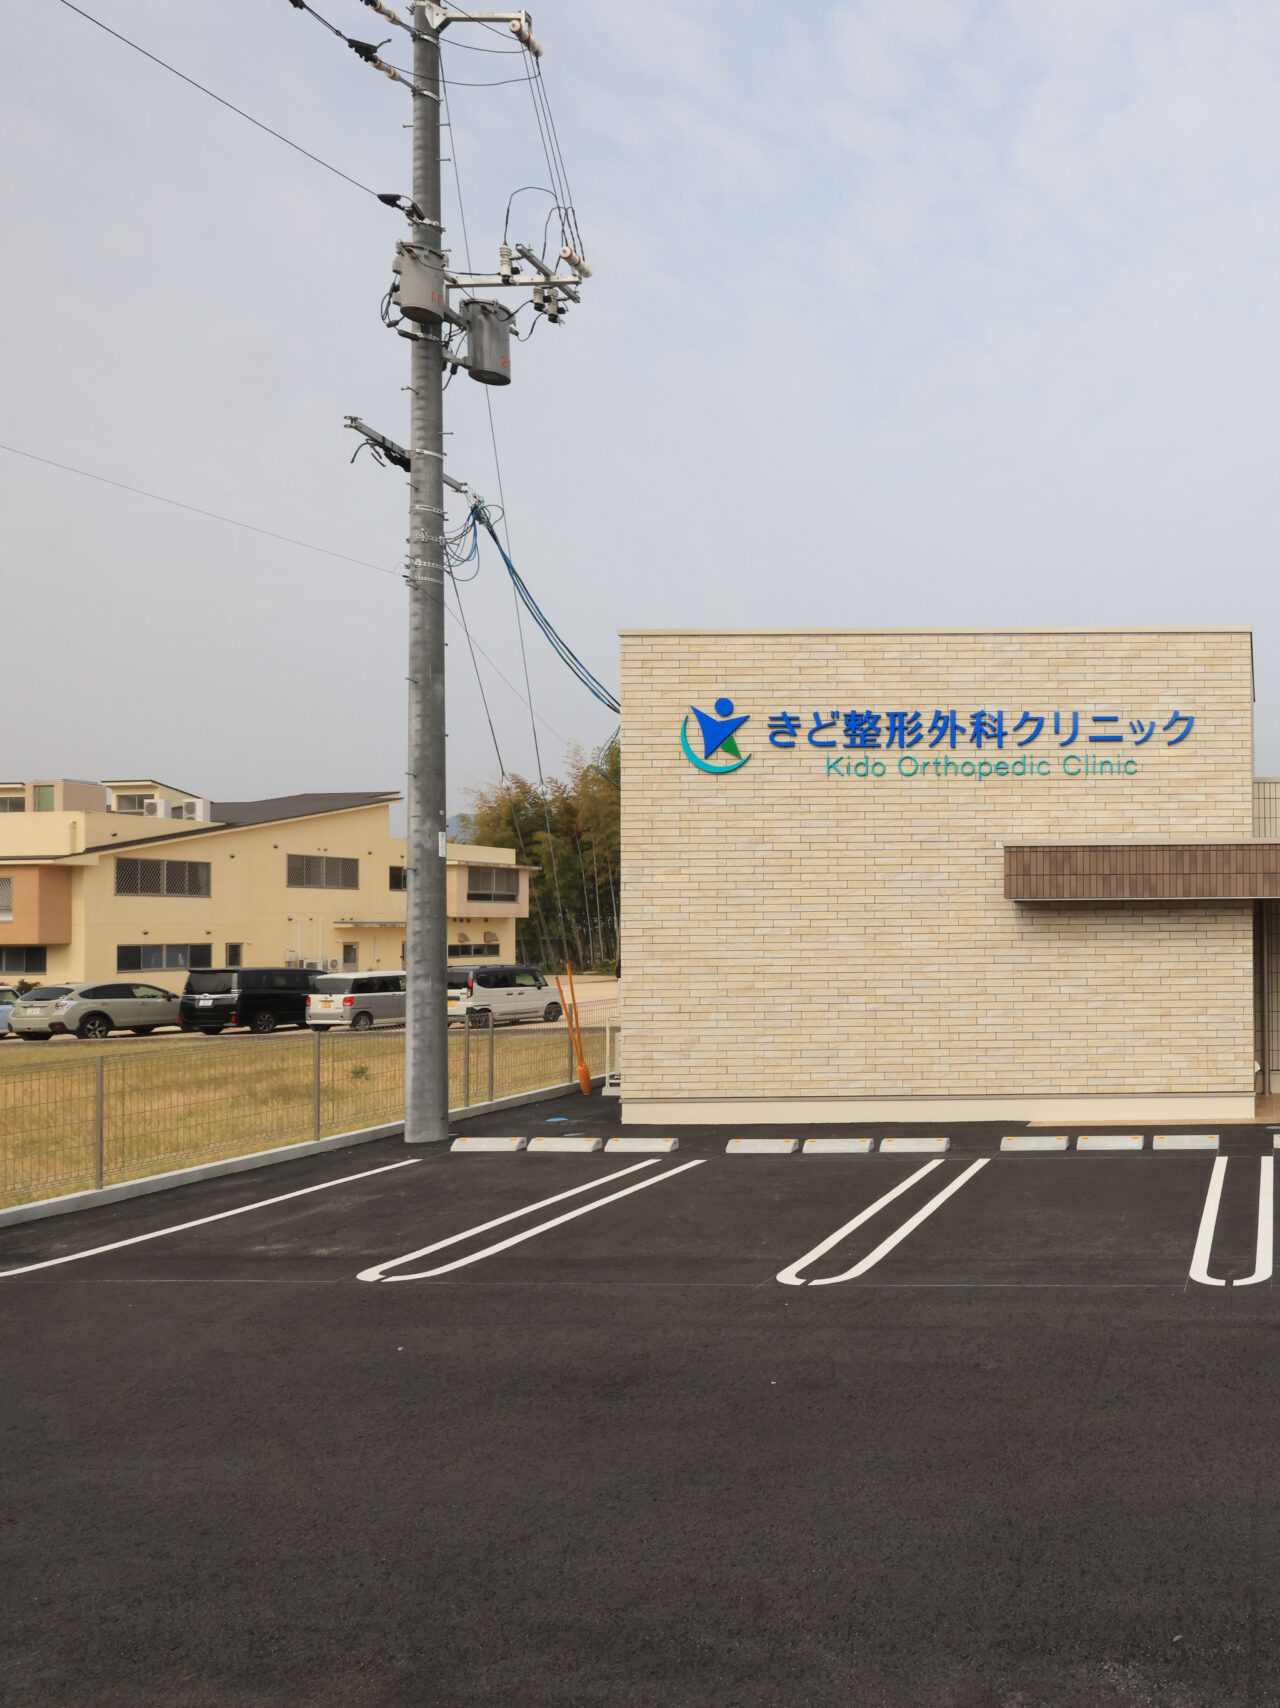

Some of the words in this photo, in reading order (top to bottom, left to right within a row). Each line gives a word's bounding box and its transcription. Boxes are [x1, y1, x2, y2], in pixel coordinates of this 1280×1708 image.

[767, 710, 1195, 748] きど整形外科クリニック
[826, 755, 886, 777] Kido
[898, 754, 1050, 781] Orthopedic
[1062, 754, 1138, 775] Clinic
